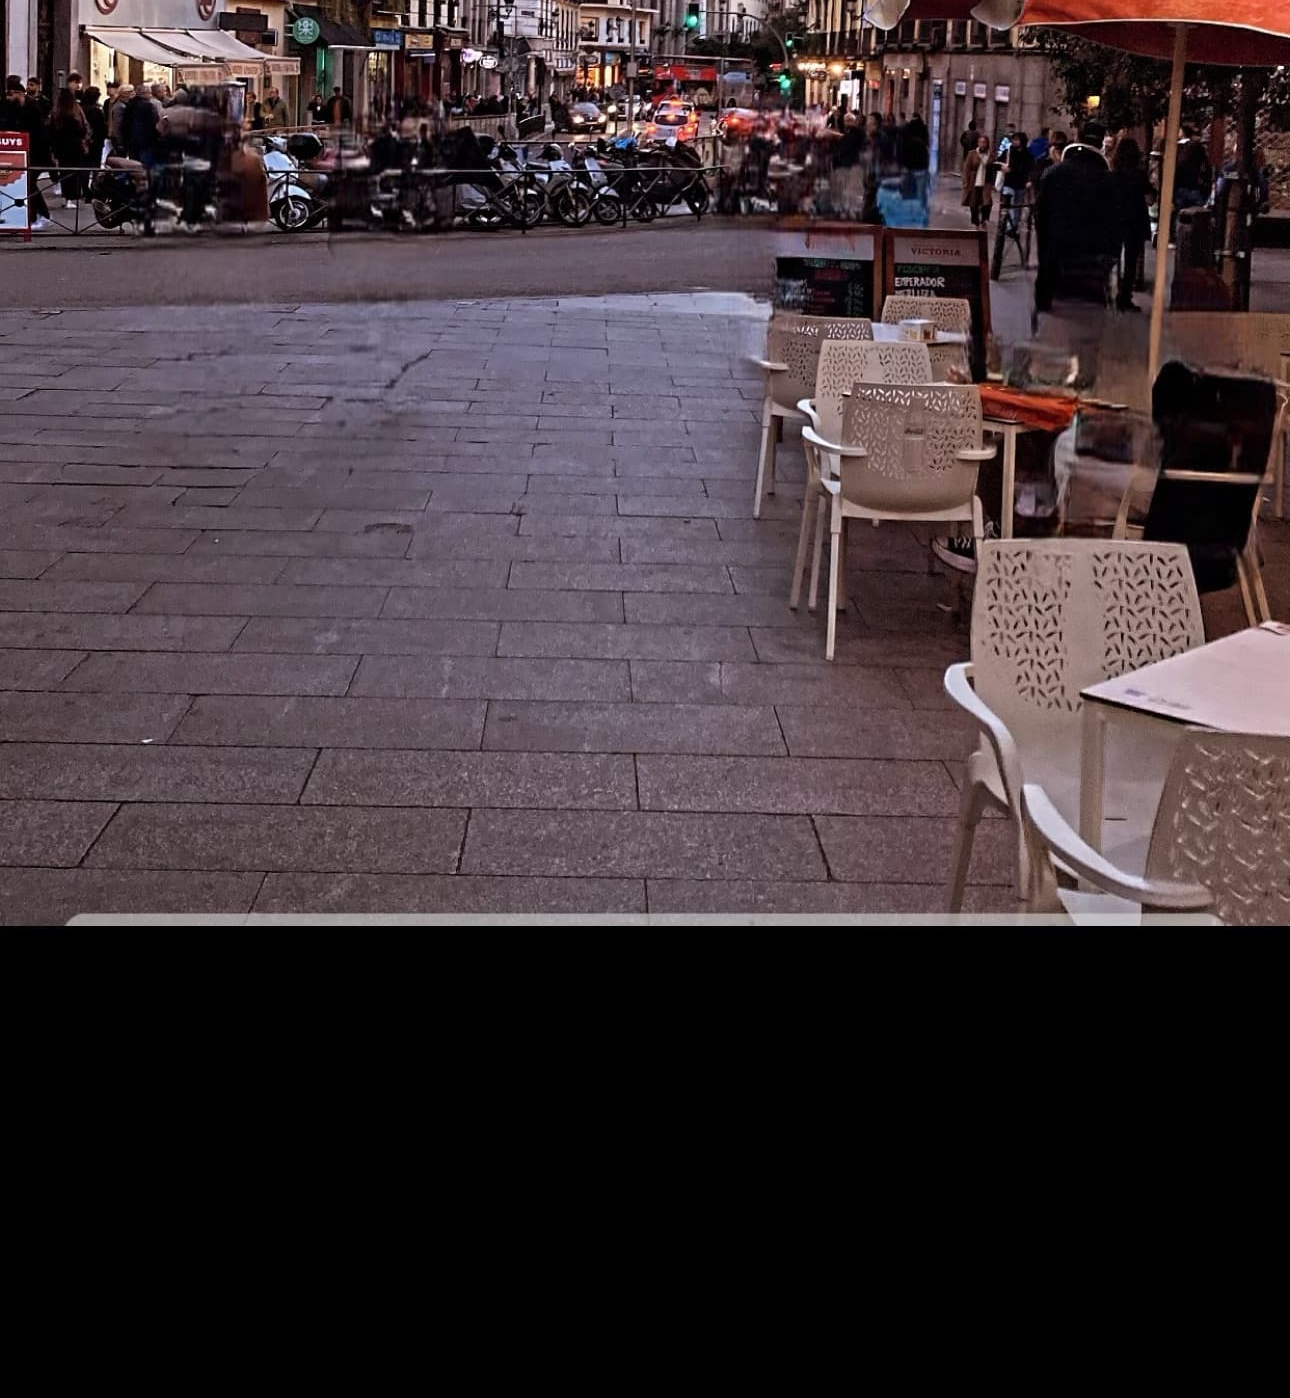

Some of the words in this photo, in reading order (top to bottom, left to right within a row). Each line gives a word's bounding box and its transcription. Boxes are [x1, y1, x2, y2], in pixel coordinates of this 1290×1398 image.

[0, 138, 23, 146] UYS
[912, 247, 960, 257] VICTORIA
[894, 276, 945, 288] EMPERADOR
